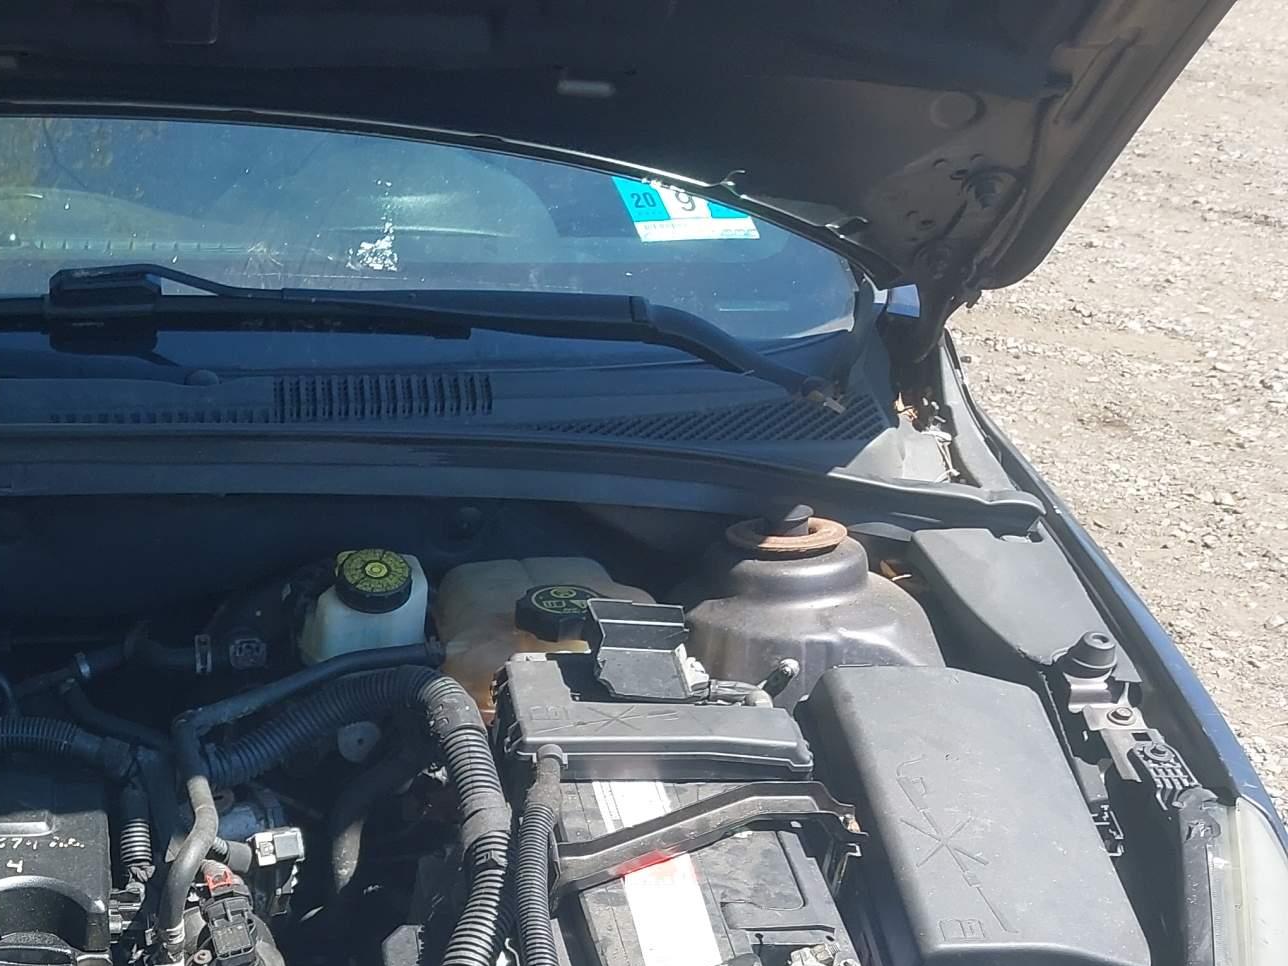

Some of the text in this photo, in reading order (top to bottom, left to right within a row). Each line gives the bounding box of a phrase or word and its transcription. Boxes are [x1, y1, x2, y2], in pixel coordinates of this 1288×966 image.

[630, 191, 657, 209] 20
[675, 191, 696, 212] 9
[6, 859, 24, 873] 4
